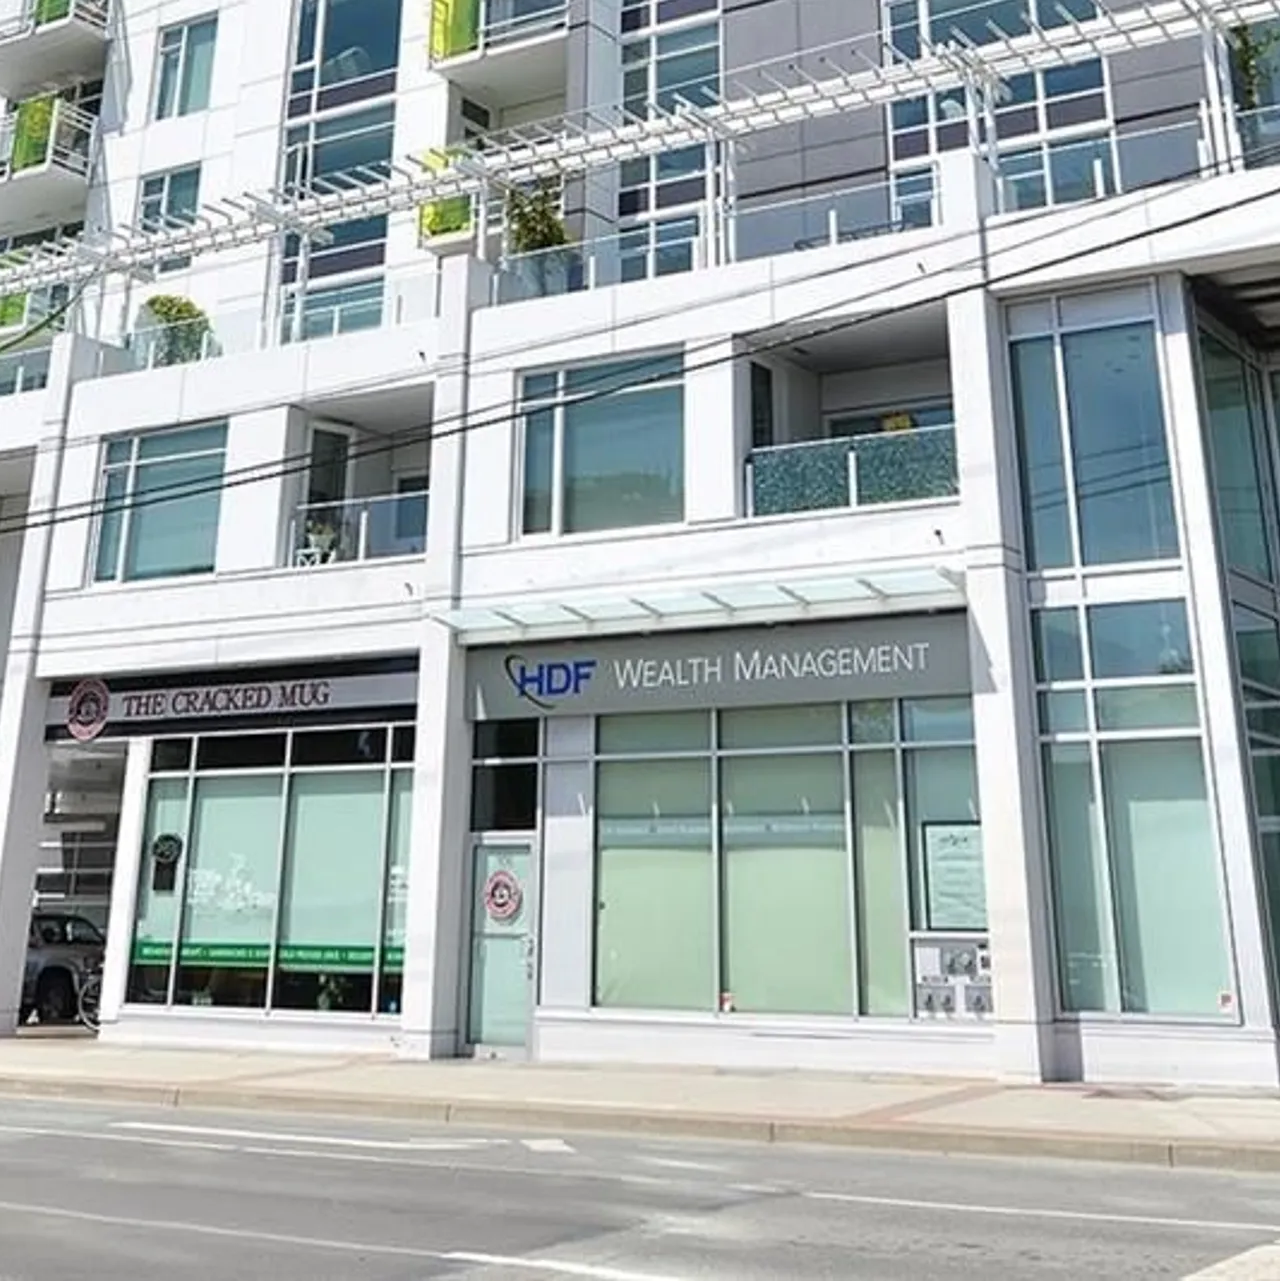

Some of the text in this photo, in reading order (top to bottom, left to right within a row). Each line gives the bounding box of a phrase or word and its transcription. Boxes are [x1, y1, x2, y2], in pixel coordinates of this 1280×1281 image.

[519, 642, 931, 697] HDF WEALTH MANAGEMENT
[122, 693, 165, 717] THE
[171, 685, 271, 715] CRACKED
[278, 680, 331, 709] MUG
